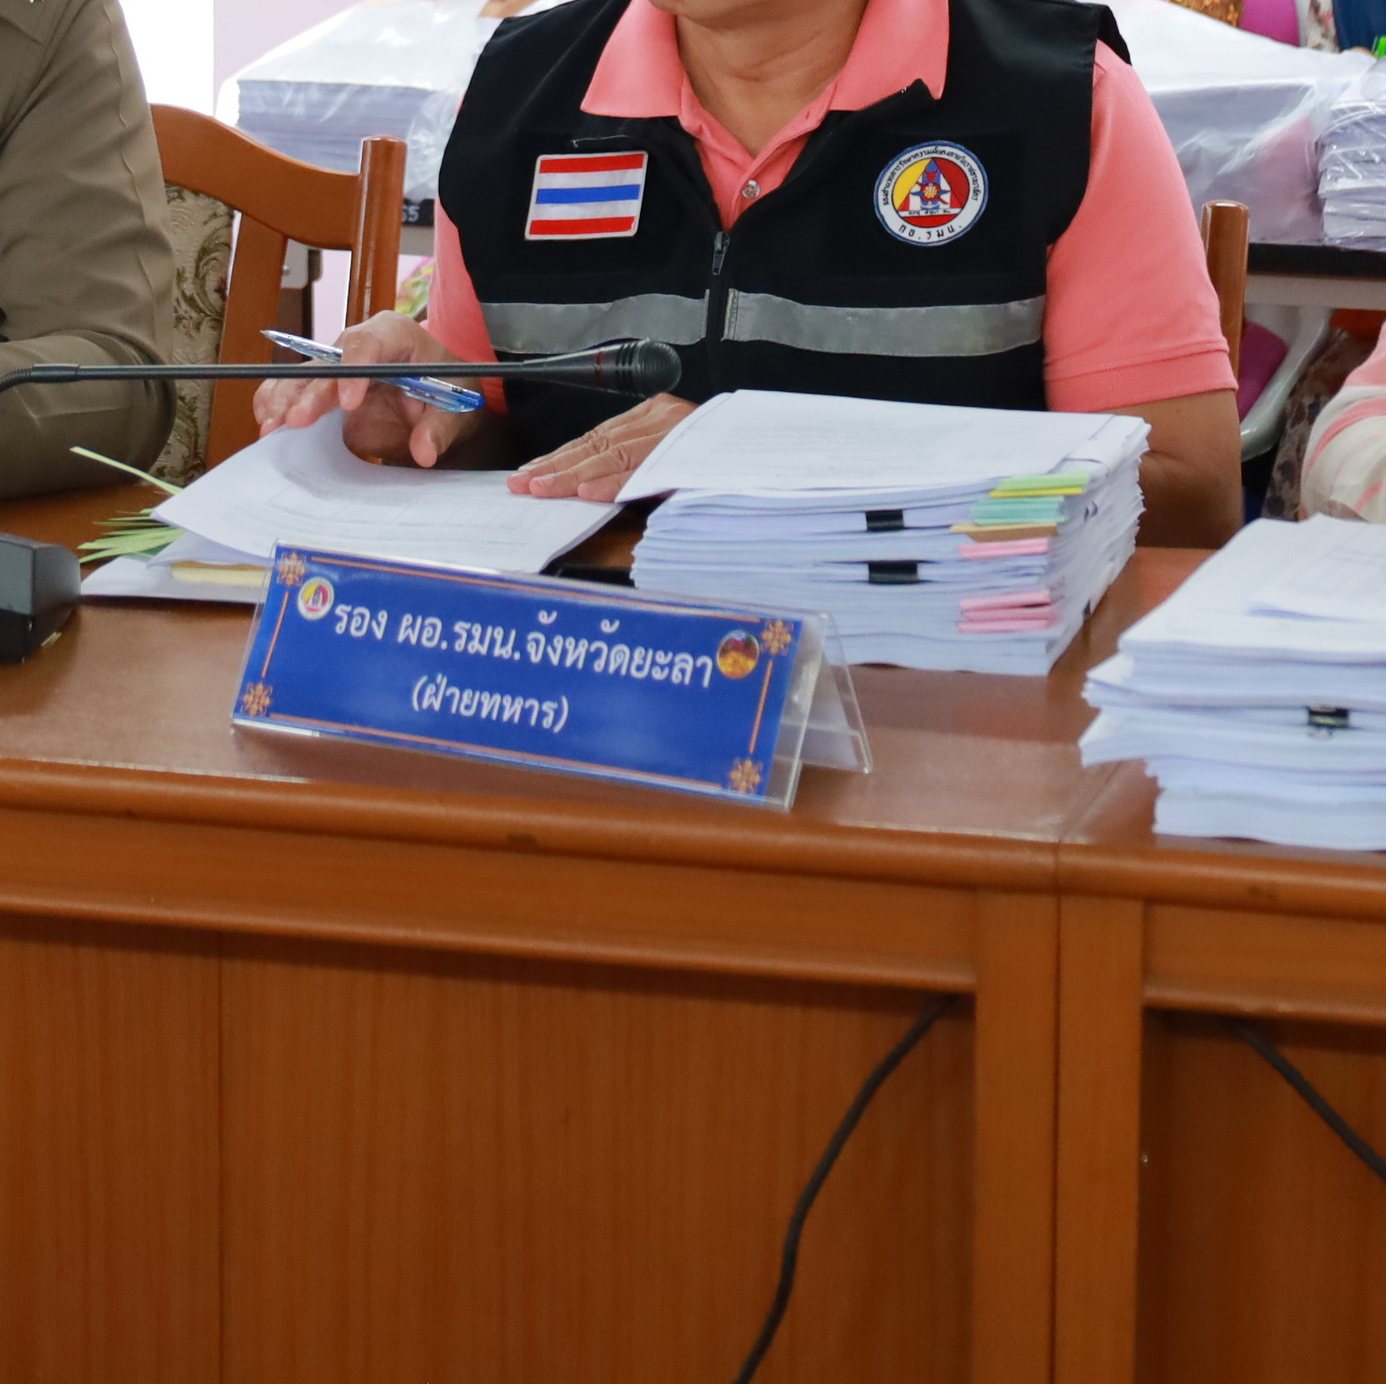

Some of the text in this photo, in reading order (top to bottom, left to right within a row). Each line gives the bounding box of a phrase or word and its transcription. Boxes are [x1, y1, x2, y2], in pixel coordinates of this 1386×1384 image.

[334, 602, 388, 638] รอง
[412, 673, 570, 734] (ฝ่ายทหาร)
